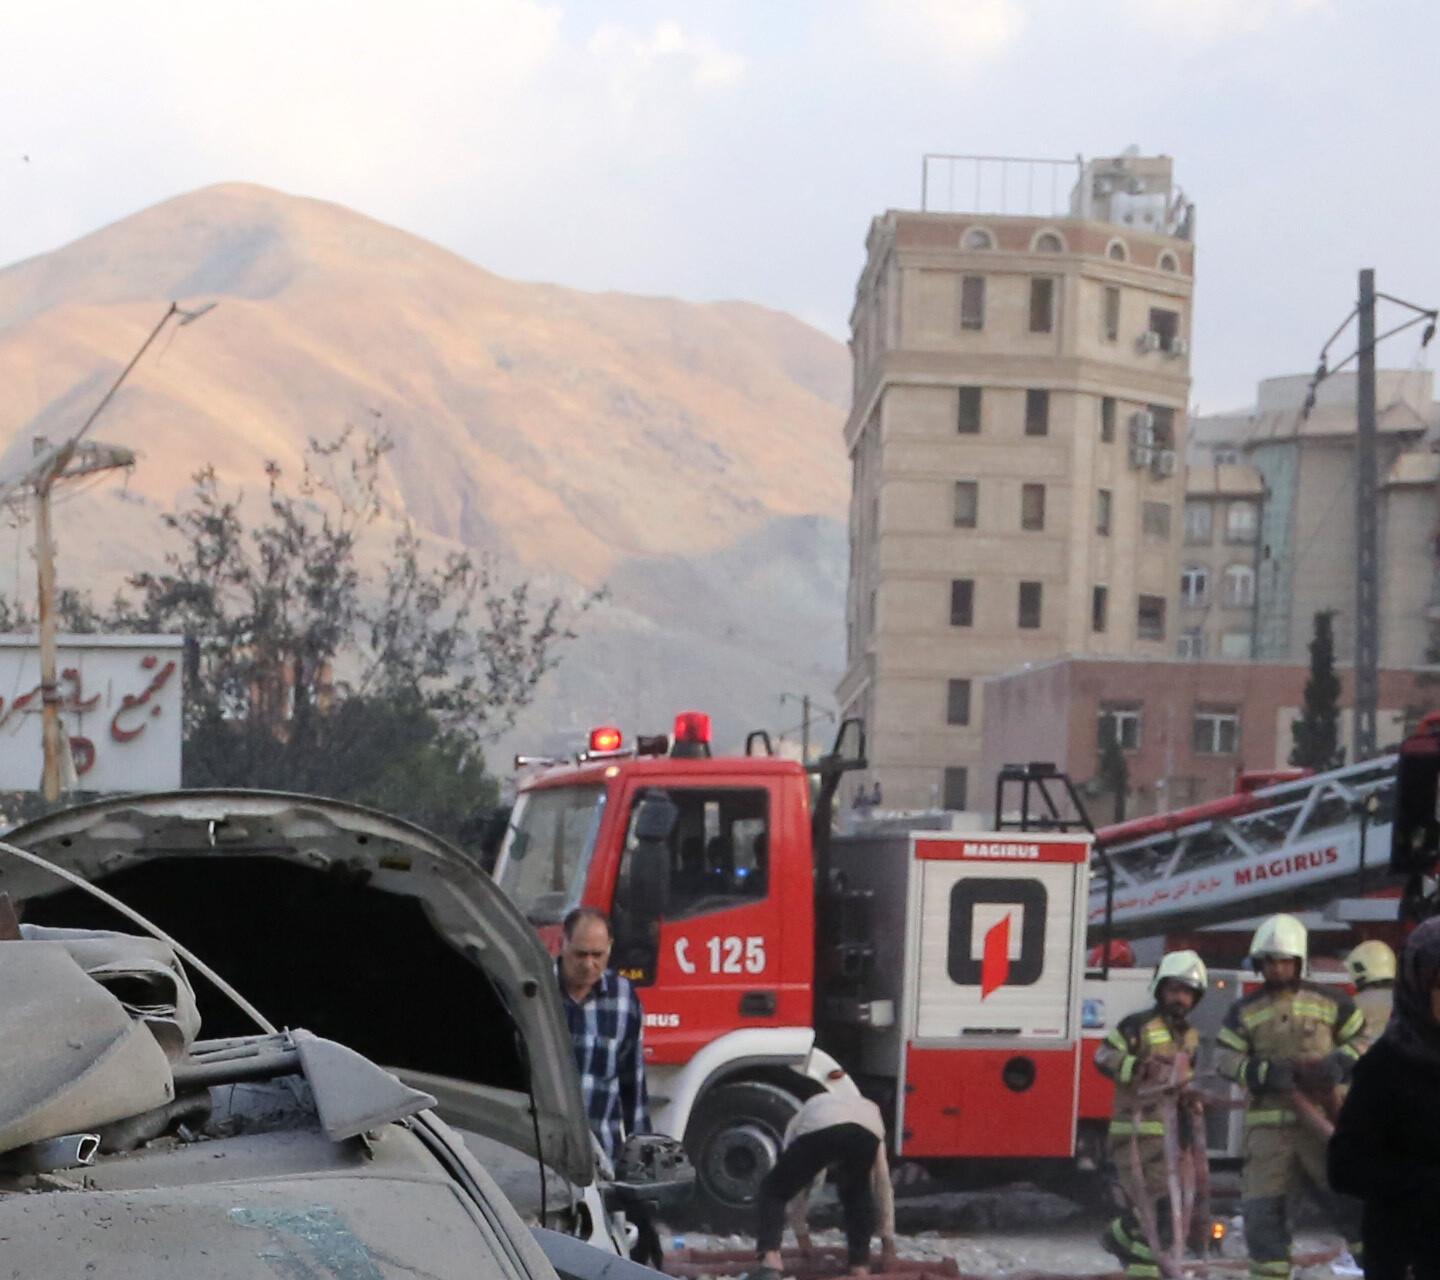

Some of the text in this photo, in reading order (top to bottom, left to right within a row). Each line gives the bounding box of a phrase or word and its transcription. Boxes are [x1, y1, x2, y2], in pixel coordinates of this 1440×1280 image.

[963, 843, 1040, 858] MAGIRUS
[1234, 847, 1339, 887] MAGIRUS
[706, 936, 766, 974] 125
